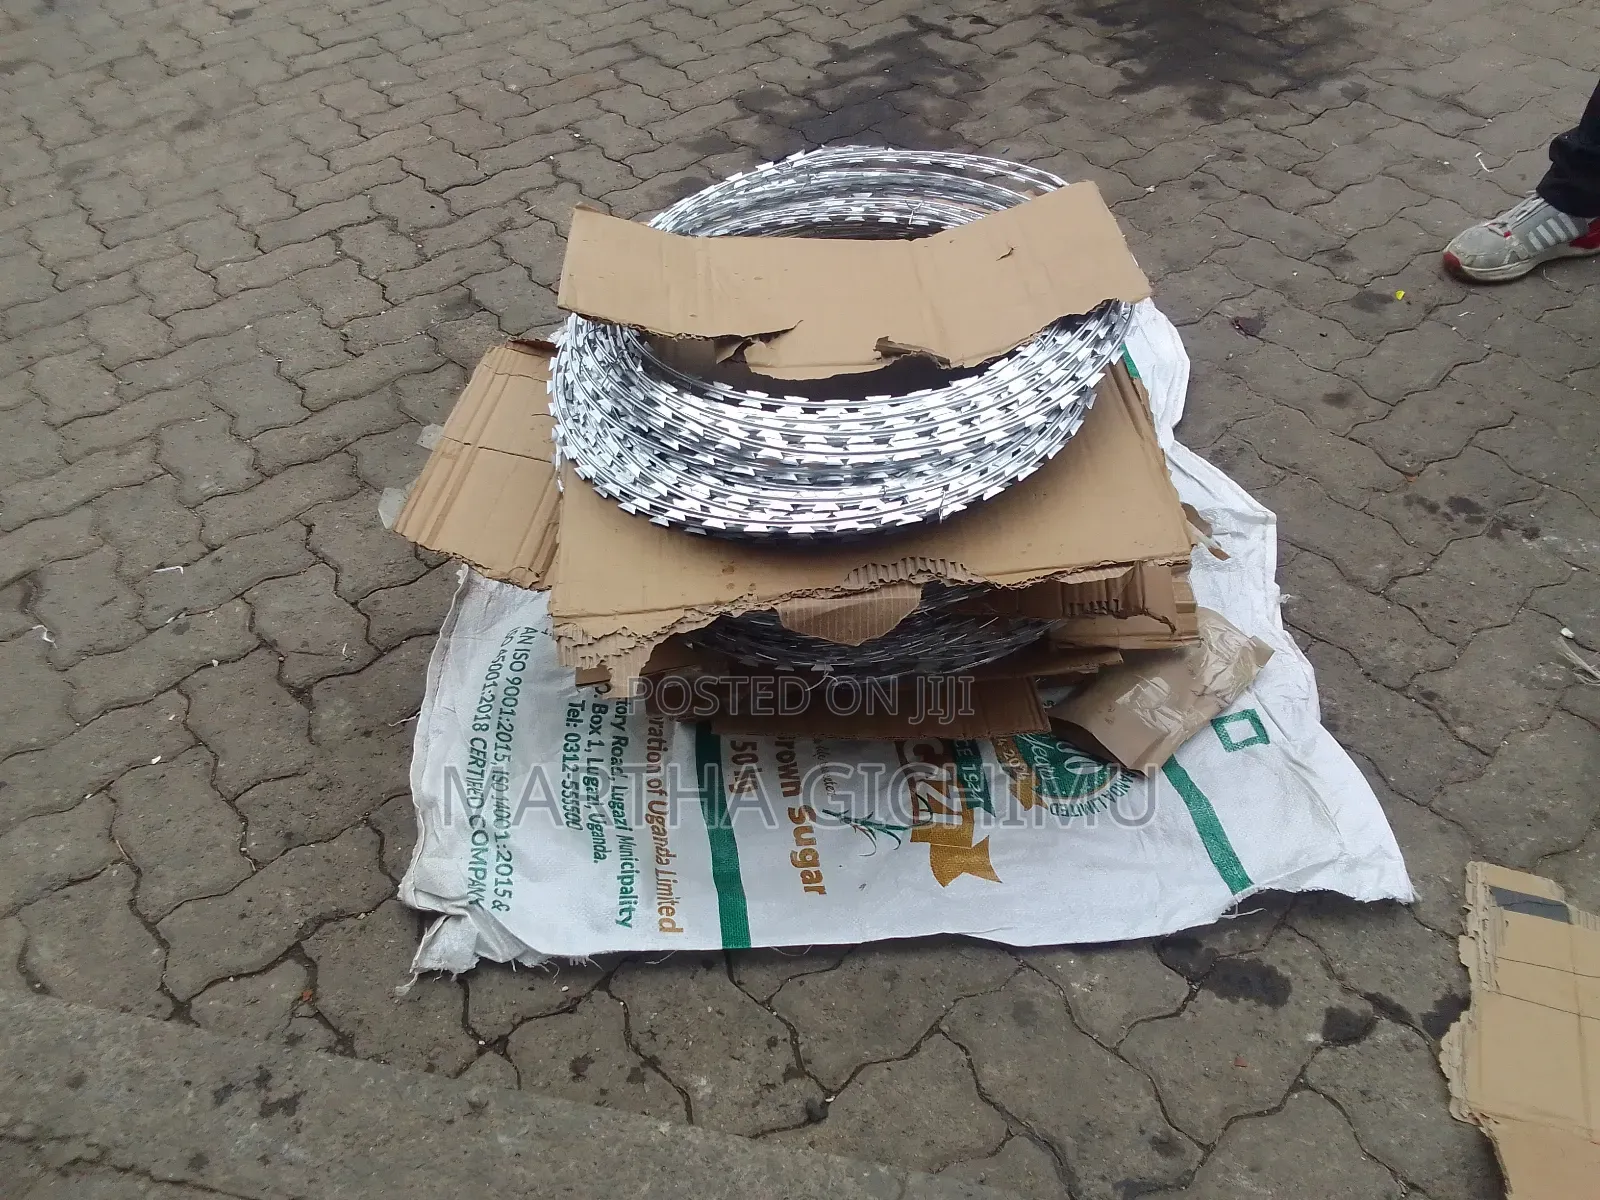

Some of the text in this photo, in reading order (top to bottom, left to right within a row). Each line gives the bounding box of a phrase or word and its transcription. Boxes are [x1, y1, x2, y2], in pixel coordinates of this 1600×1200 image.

[516, 626, 539, 645] AN
[509, 649, 531, 672] ISO
[471, 649, 508, 732] 45001:2018
[591, 702, 609, 735] Box
[610, 697, 631, 732] tory
[561, 700, 586, 831] Tel: 0312-555500
[584, 739, 605, 752] 1,
[729, 740, 759, 765] 50
[491, 767, 510, 792] ISO
[607, 785, 634, 831] Lugazi
[644, 716, 684, 933] ration of Uganda Limited
[774, 736, 828, 896] rown Sugar
[585, 813, 612, 864] Uganda.
[466, 814, 489, 911] COMPANY
[614, 834, 640, 929] Municipality
[491, 900, 511, 912] &
